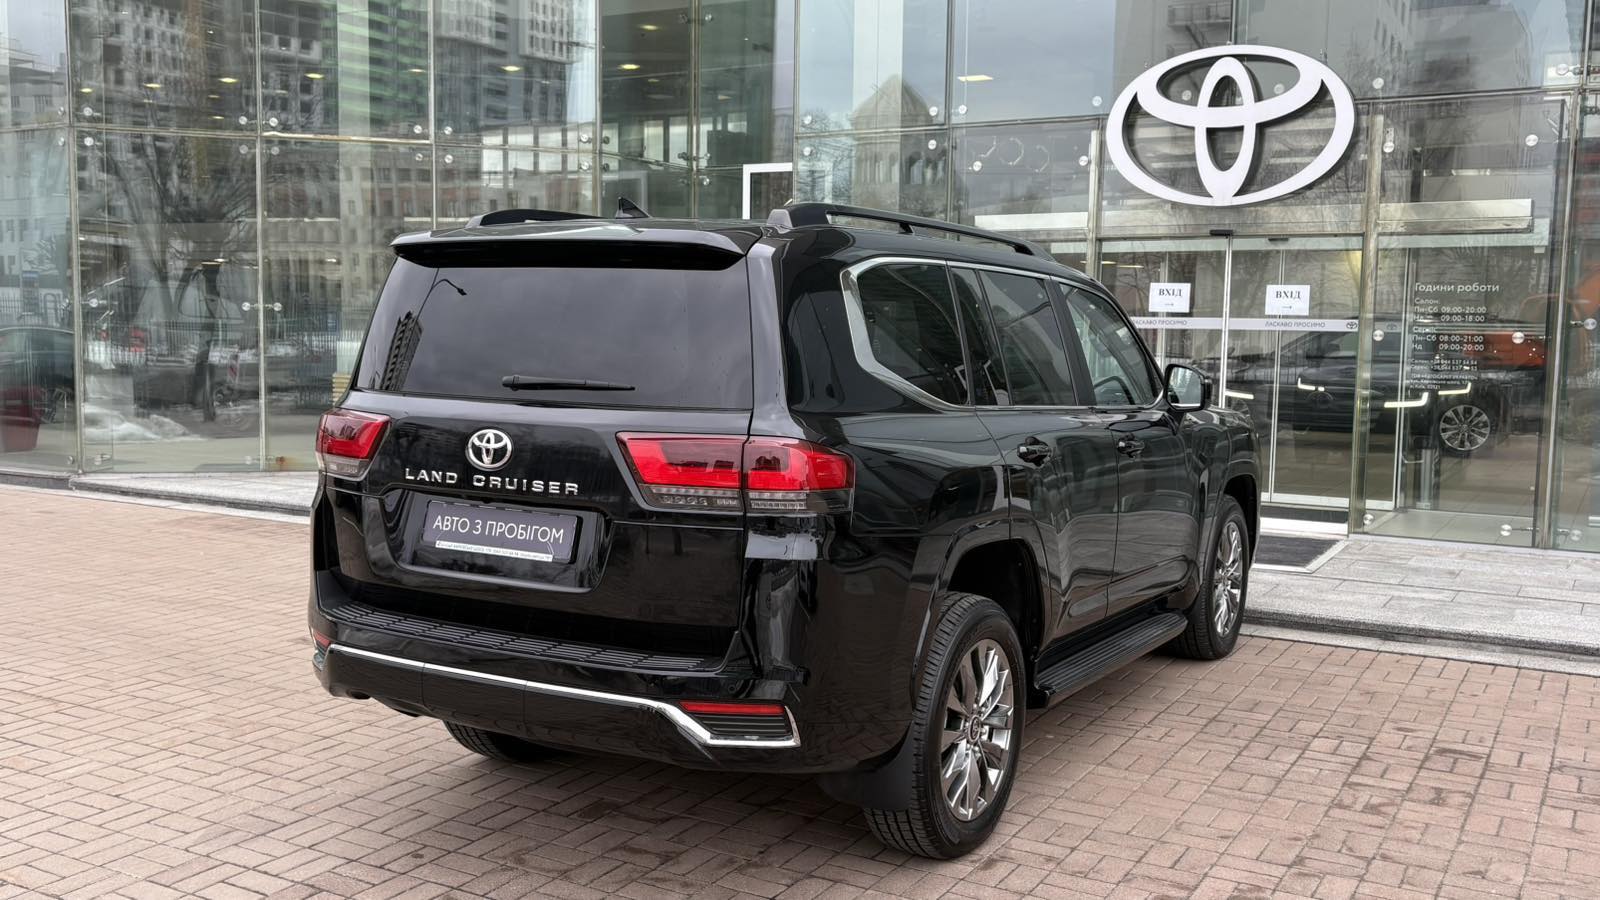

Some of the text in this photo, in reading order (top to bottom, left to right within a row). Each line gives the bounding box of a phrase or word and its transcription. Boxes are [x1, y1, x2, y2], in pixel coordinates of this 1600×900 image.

[1158, 288, 1183, 297] ВХІД
[1415, 282, 1500, 294] Години роботи
[1275, 290, 1302, 300] ВХІД
[1440, 306, 1487, 314] 09:00-20:00
[1412, 334, 1484, 343] Пн-Сб 08:00-21:00
[1438, 343, 1485, 351] 09:00-20:00
[405, 468, 579, 495] LAND CRUISER
[433, 515, 470, 533] АВТО
[485, 521, 565, 544] ПРОБІГОМ
